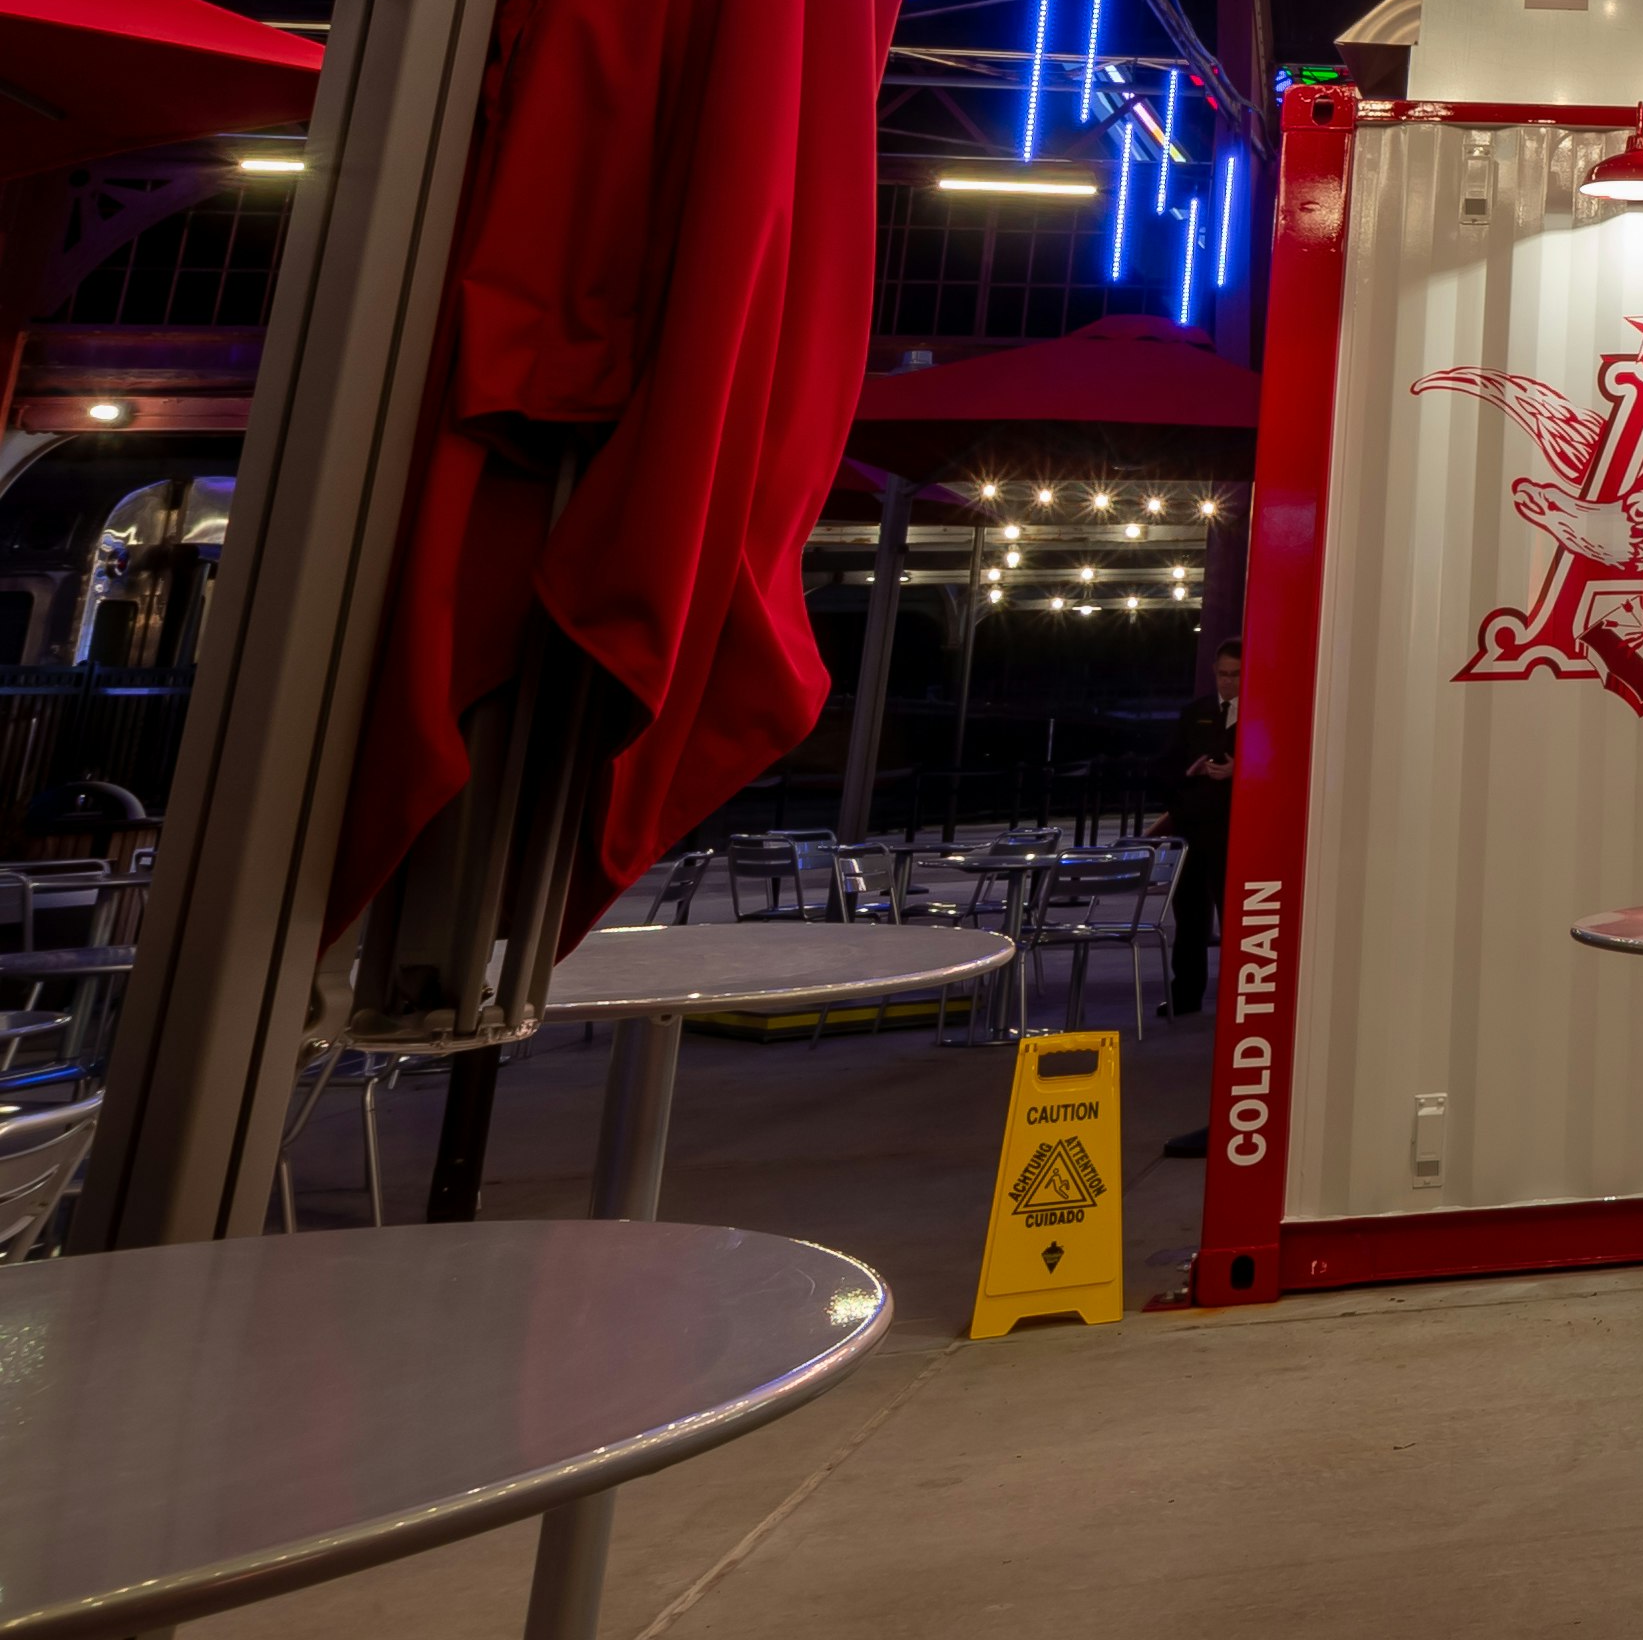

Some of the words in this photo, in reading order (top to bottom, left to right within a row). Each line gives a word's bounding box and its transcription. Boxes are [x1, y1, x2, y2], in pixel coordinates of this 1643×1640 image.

[1235, 880, 1282, 1023] TRAIN
[1026, 1101, 1099, 1125] CAUTION
[1227, 1036, 1272, 1166] COLD
[1008, 1142, 1053, 1204] ACHTUNG
[1064, 1135, 1107, 1198] ATTENTION
[1025, 1209, 1085, 1228] CUIDADO
